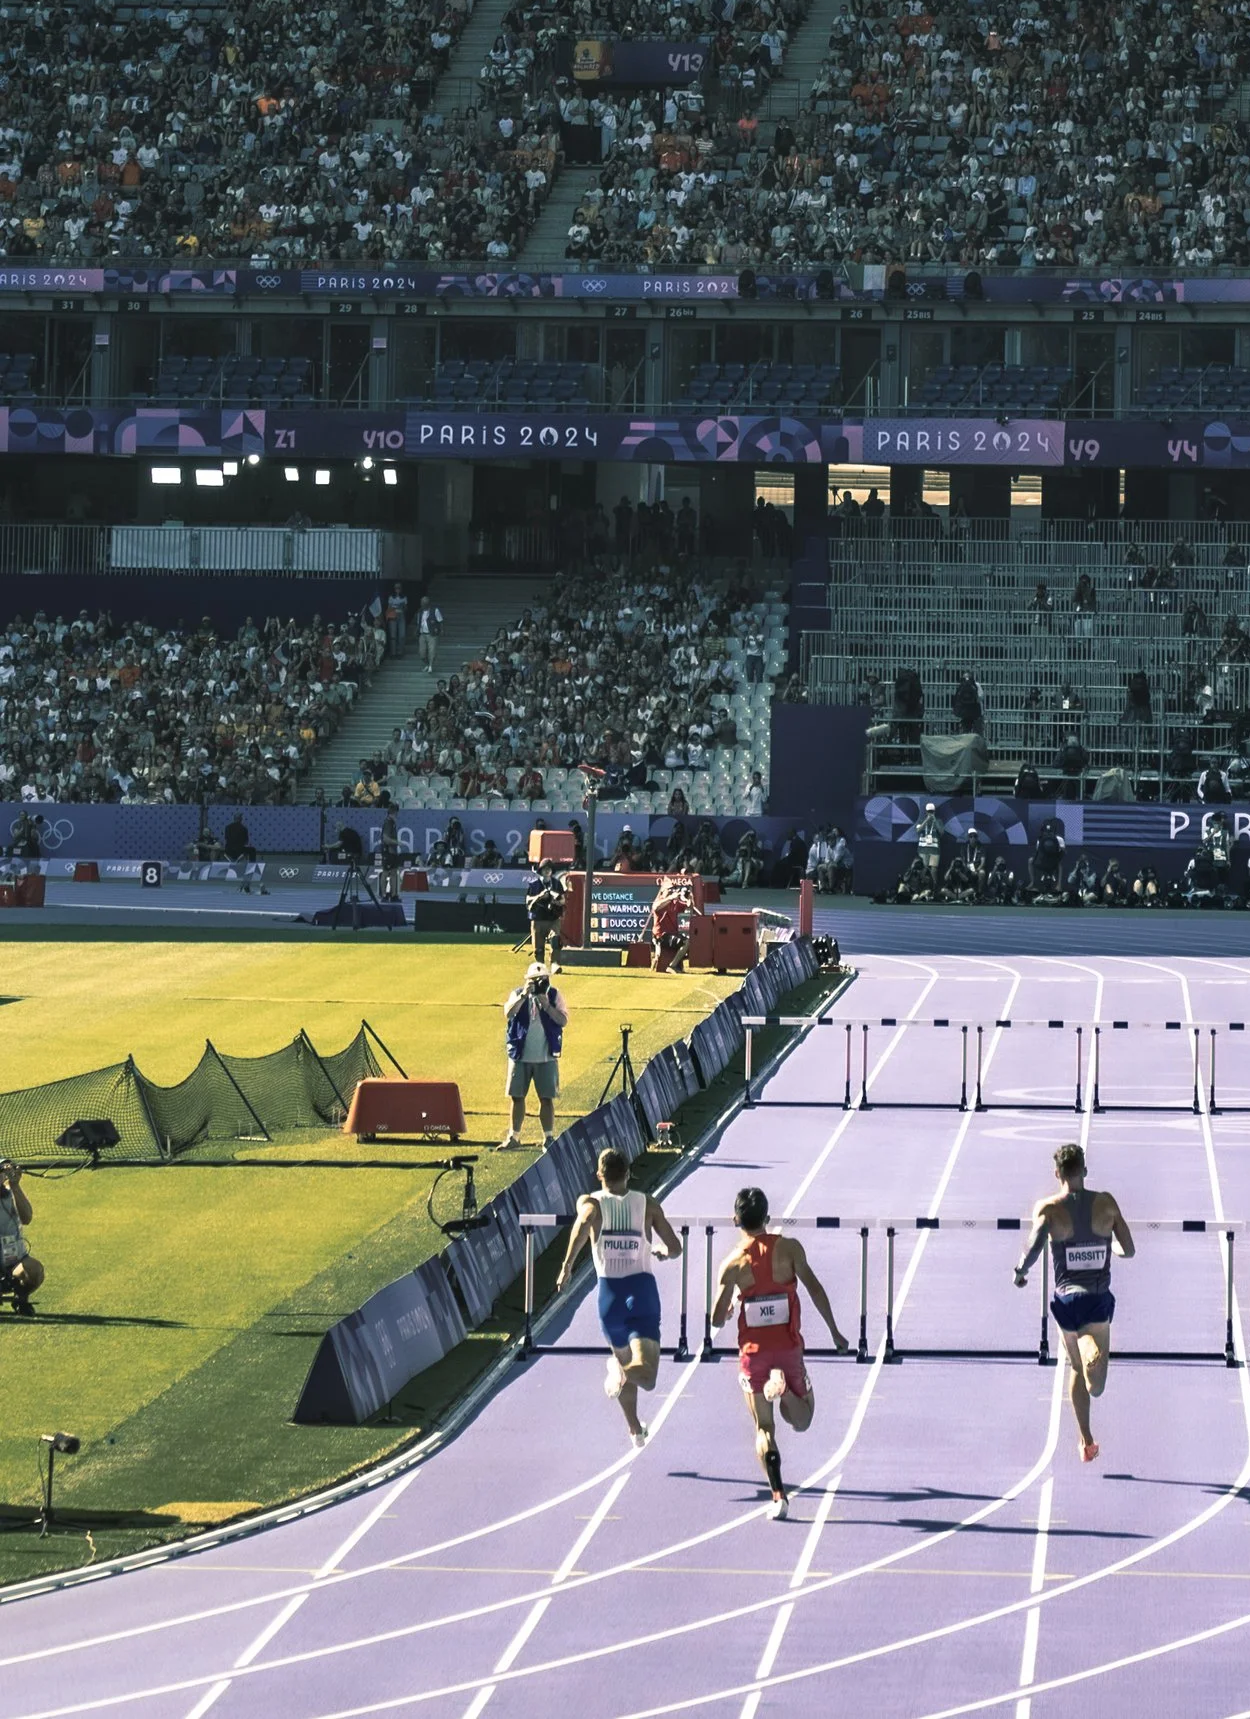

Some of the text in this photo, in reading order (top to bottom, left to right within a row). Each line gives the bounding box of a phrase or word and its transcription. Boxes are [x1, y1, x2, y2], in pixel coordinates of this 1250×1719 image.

[668, 53, 703, 72] Y13
[44, 274, 87, 286] 2024
[318, 276, 416, 290] PARIS 2024
[643, 281, 690, 293] PARIS
[61, 301, 74, 311] 31
[127, 301, 140, 311] 30
[339, 303, 352, 313] 29
[404, 303, 417, 314] 28
[614, 306, 627, 317] 27
[850, 309, 863, 319] 26
[1082, 311, 1095, 321] 25
[275, 429, 296, 449] Z1
[420, 424, 598, 447] PARIS 2024
[878, 431, 1049, 452] PARIS 2024
[1070, 440, 1100, 461] Y9
[1168, 441, 1198, 462] Y4
[145, 867, 158, 884] 8
[609, 905, 650, 913] WARHOLM
[610, 919, 637, 928] DUCOS
[603, 1240, 639, 1251] MULLER
[1068, 1250, 1106, 1262] BASSITT
[759, 1305, 775, 1317] XIE
